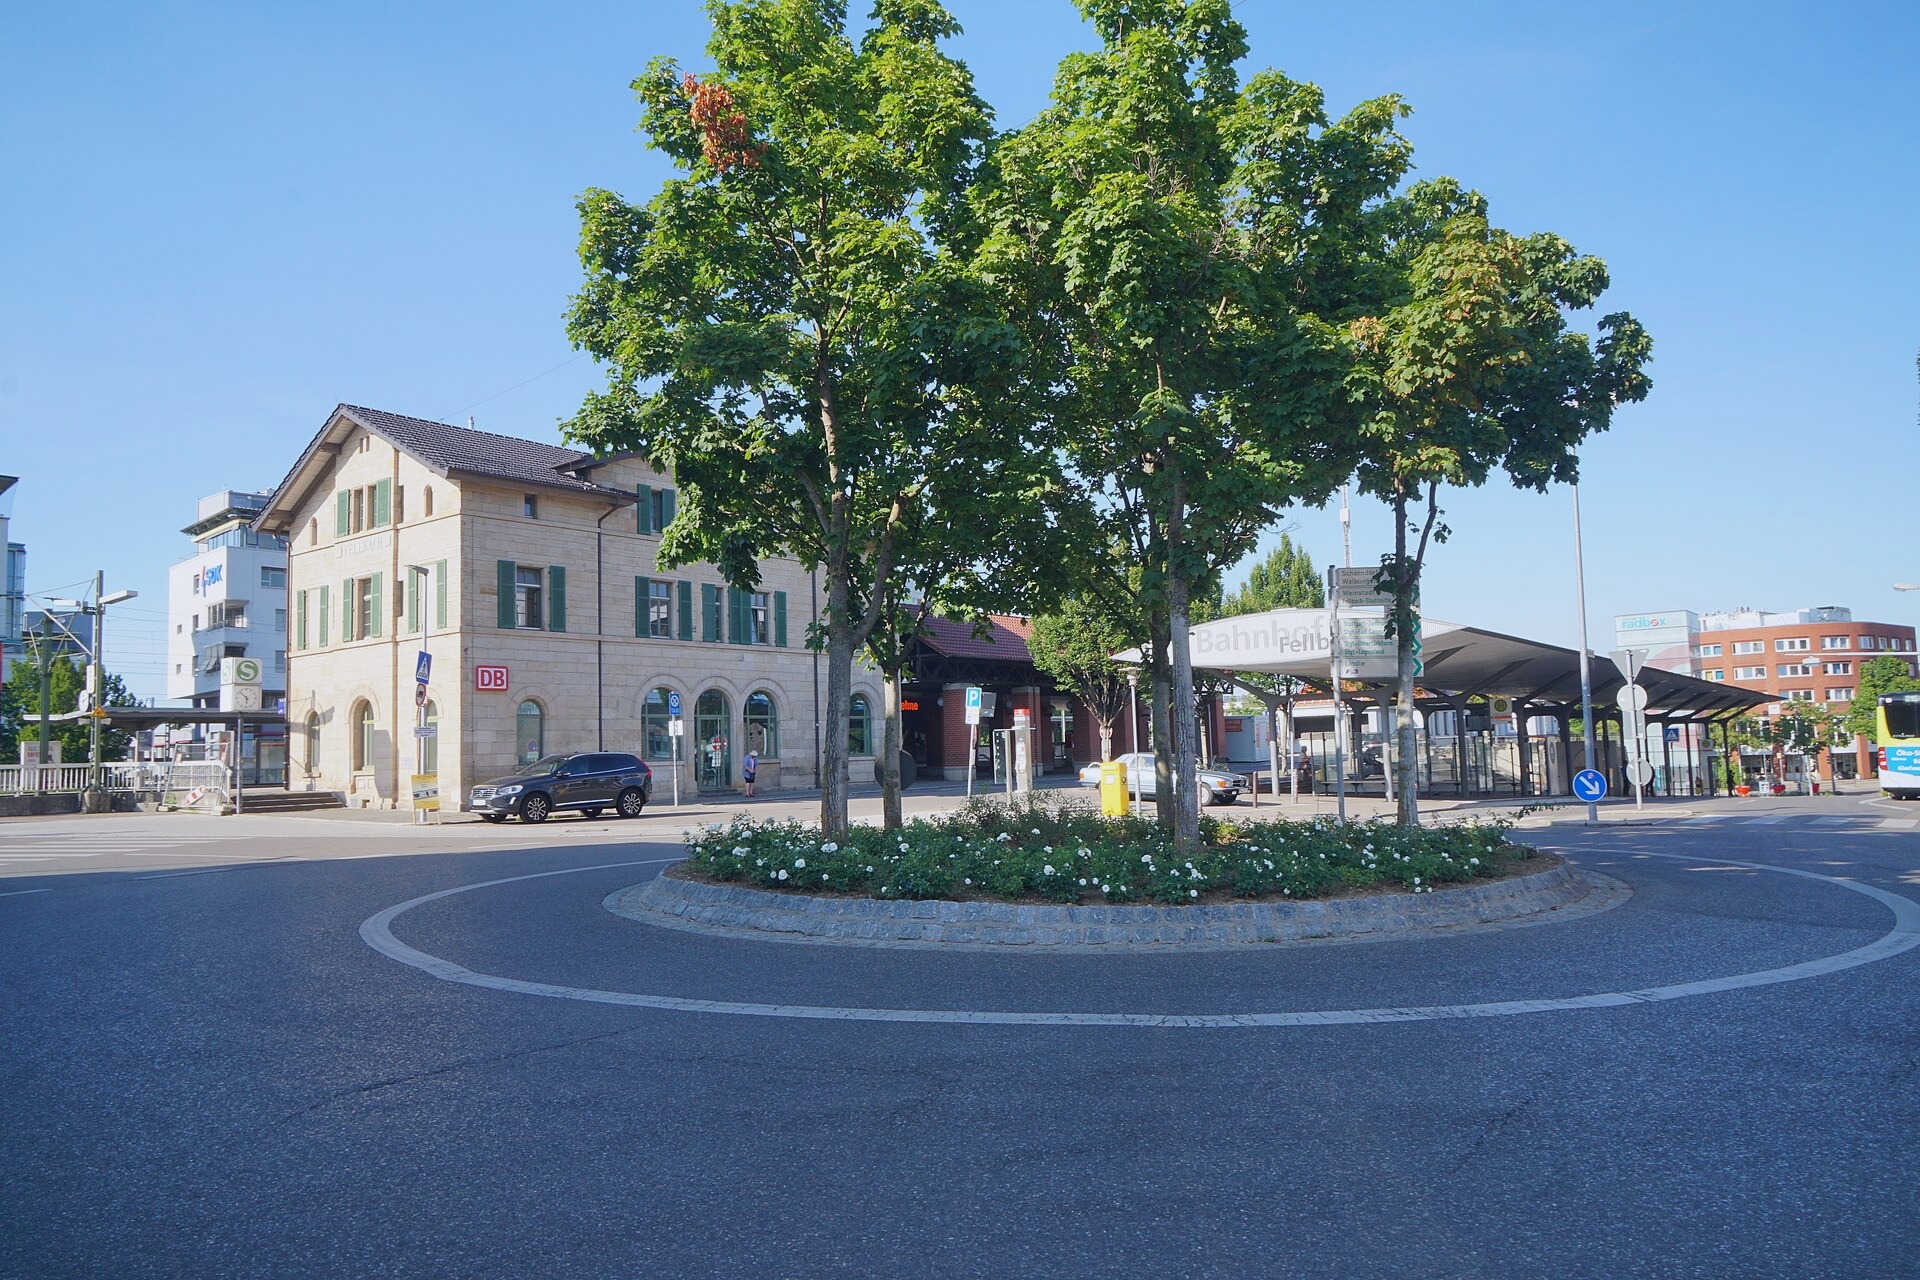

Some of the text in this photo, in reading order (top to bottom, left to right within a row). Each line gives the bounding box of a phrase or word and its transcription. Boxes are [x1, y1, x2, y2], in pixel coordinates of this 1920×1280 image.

[344, 537, 383, 556] FELLBACH
[204, 564, 223, 587] SDK
[1341, 569, 1378, 577] Schorndorf
[1621, 617, 1666, 629] radbox
[1196, 615, 1325, 653] Bahnhof
[238, 660, 257, 681] S
[480, 669, 505, 687] DB
[968, 689, 979, 706] P
